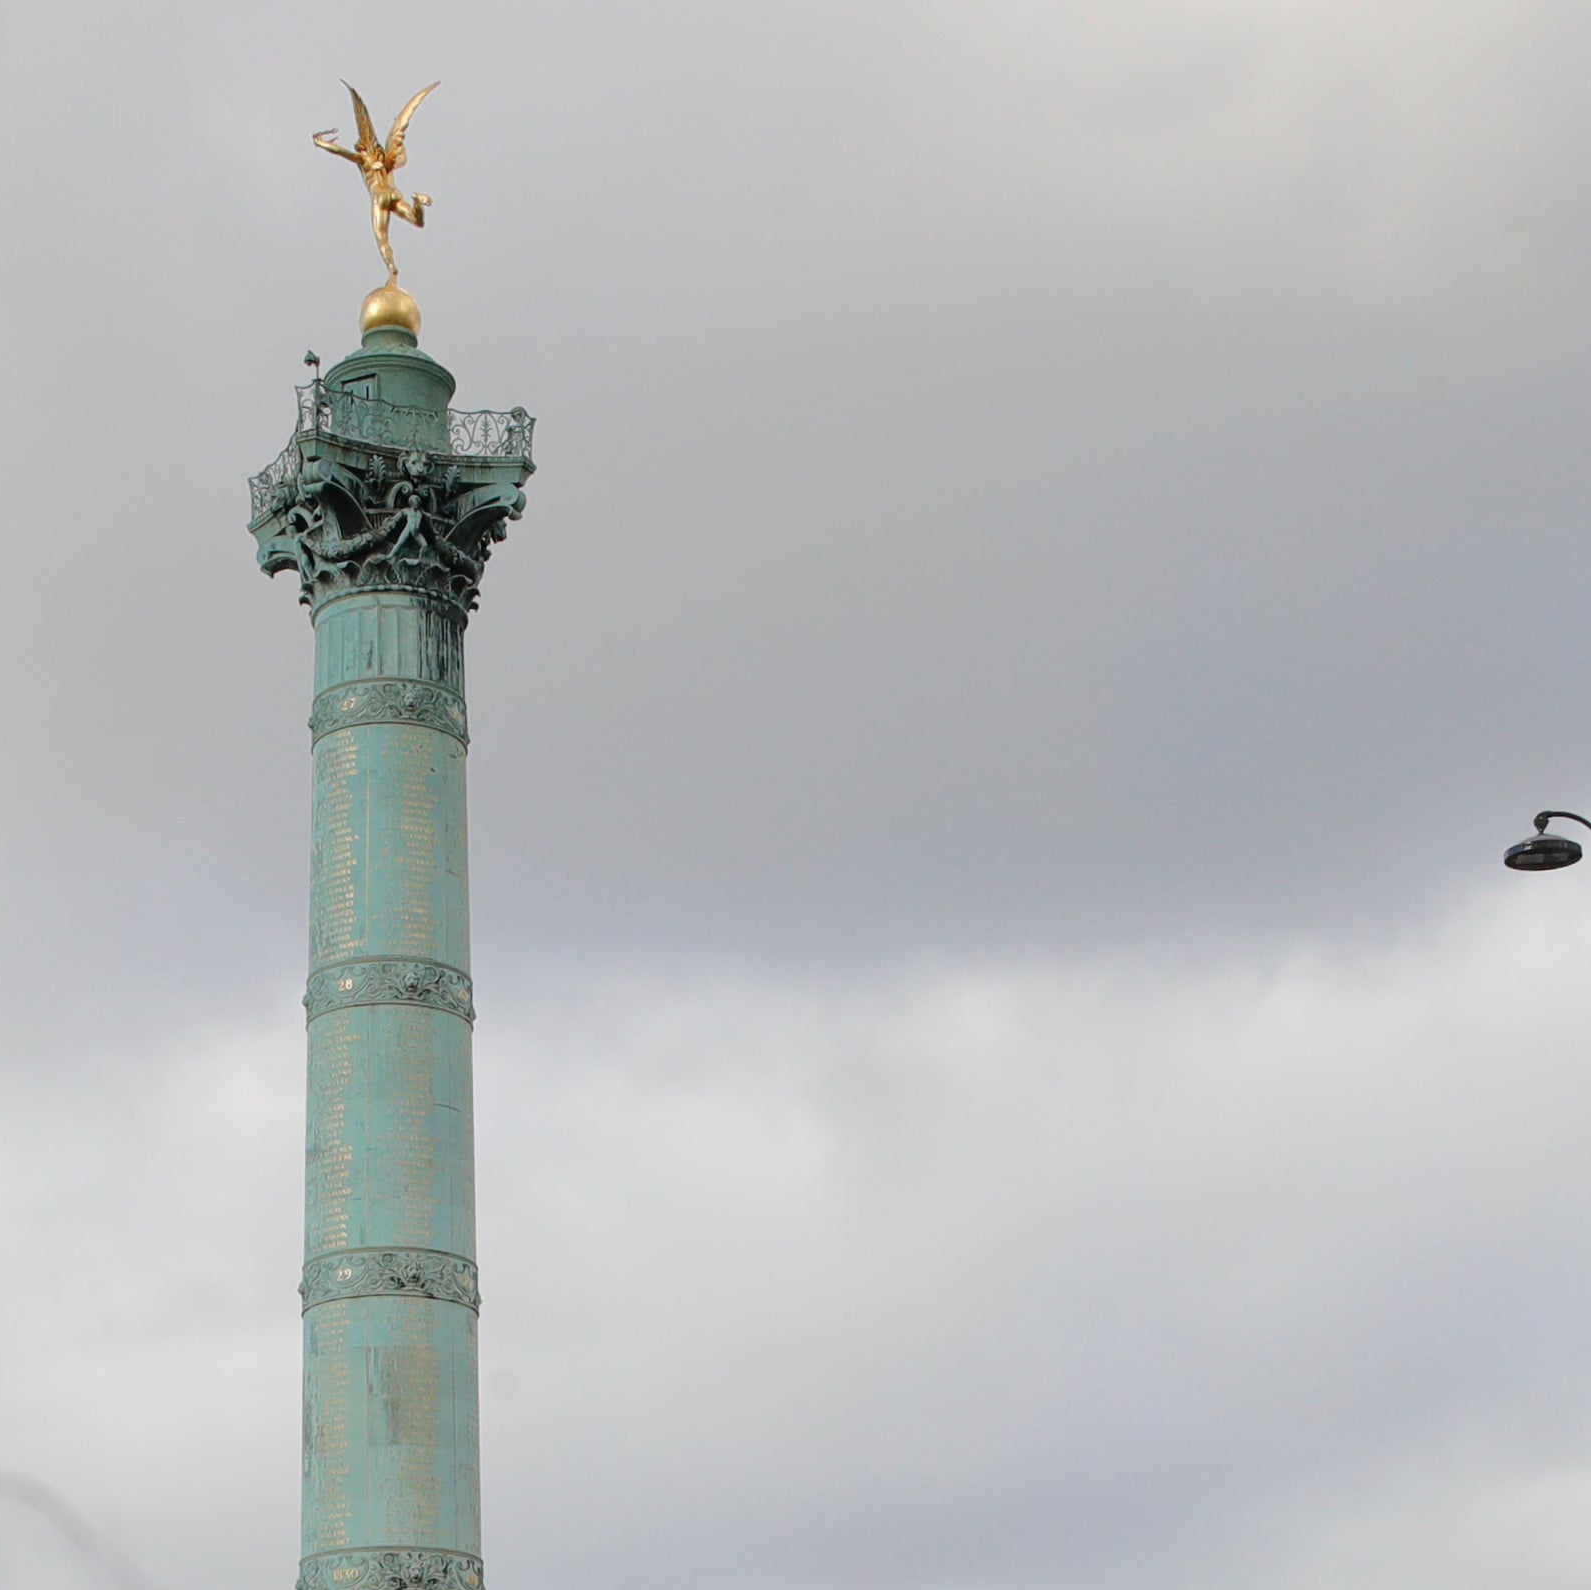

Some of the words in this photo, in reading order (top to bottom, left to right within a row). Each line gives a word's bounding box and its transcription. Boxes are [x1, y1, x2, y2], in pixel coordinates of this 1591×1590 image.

[339, 978, 353, 991] 28
[336, 1268, 353, 1282] 29
[333, 1569, 359, 1582] 1830
